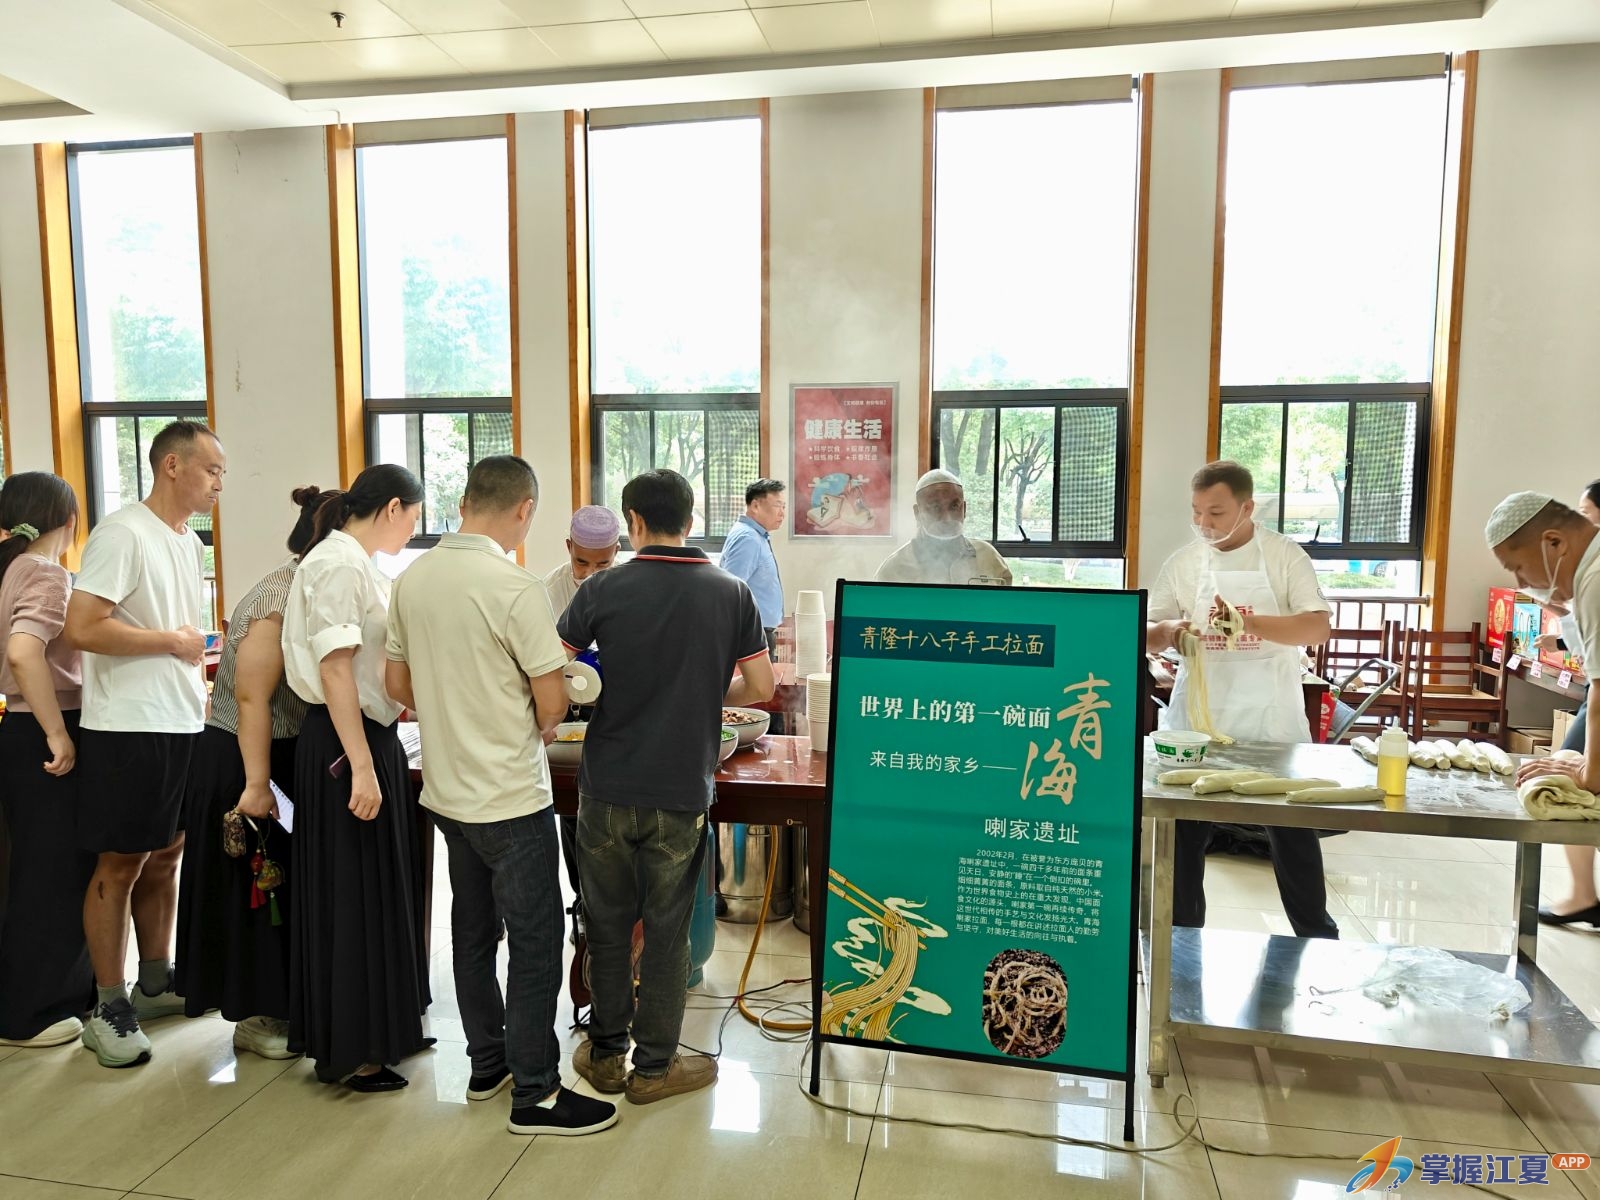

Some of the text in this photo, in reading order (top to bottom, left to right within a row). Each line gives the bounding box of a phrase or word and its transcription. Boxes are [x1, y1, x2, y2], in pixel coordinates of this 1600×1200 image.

[804, 418, 883, 440] 健康生活
[859, 625, 1045, 656] 青隆十八子手工拉面
[859, 695, 1051, 729] 世界上的第一碗面
[1020, 672, 1112, 805] 青海
[984, 817, 1080, 845] 喇家遗址
